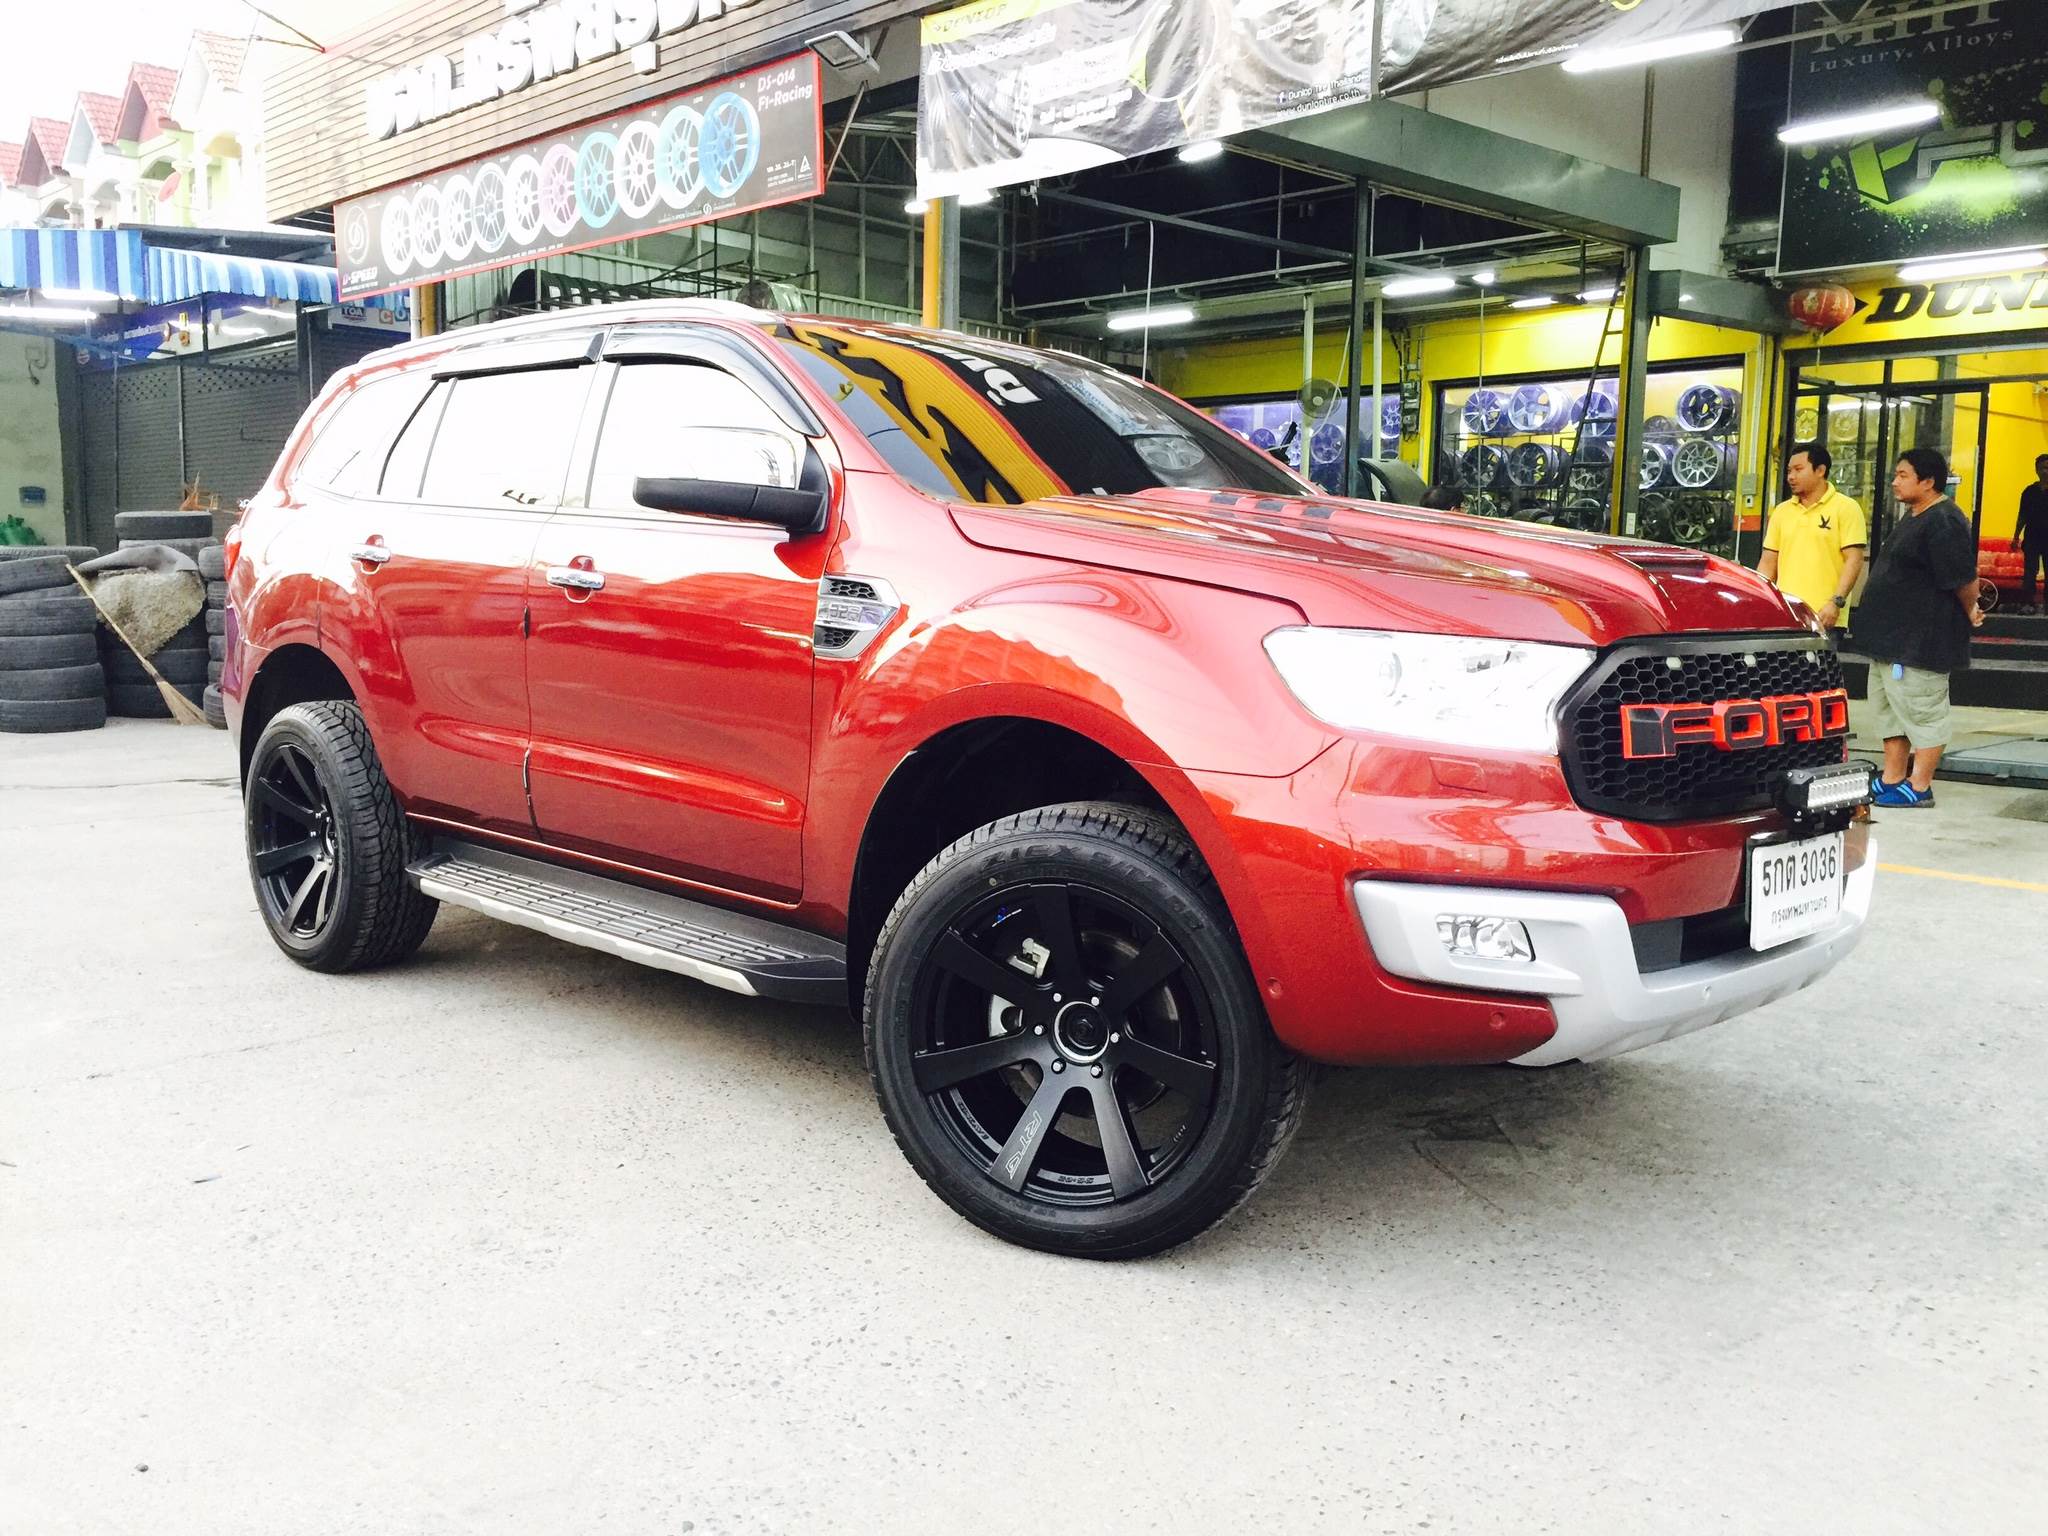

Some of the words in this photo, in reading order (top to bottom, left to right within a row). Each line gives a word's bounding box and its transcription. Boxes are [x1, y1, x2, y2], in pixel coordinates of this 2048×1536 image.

[1923, 30, 2014, 53] Alloys
[758, 68, 796, 92] DS-014
[1288, 88, 1313, 100] Dunlop
[1621, 688, 1850, 759] FORD
[1800, 845, 1837, 887] 3036
